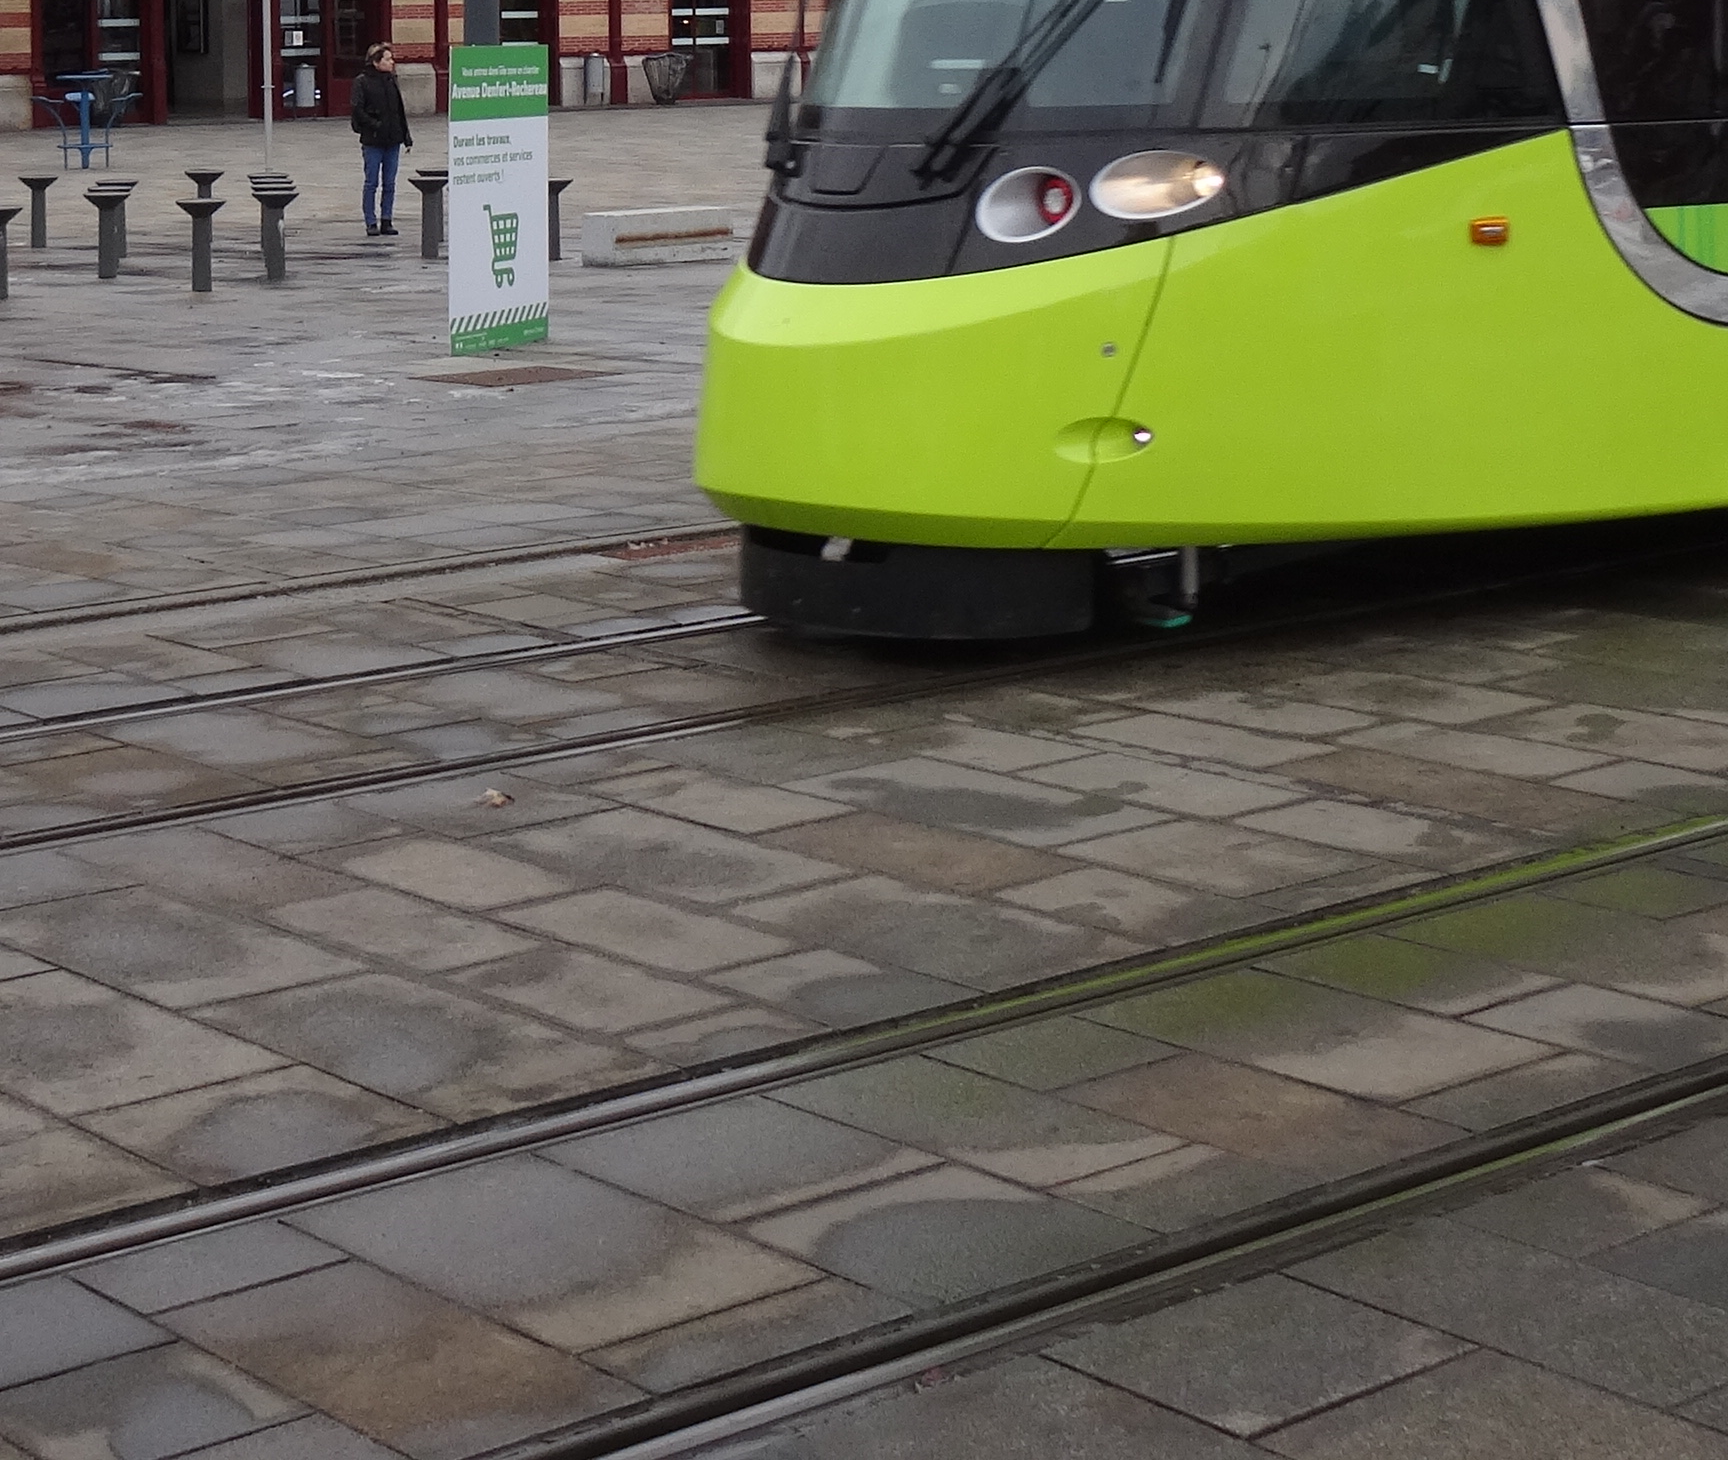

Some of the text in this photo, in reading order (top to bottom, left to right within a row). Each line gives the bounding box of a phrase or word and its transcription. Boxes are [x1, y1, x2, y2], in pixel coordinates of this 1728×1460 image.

[452, 83, 480, 99] Avenue
[453, 135, 475, 148] Durant
[475, 133, 486, 146] les
[453, 149, 533, 167] vos commerces et services
[453, 172, 476, 185] restent
[477, 171, 501, 184] ouverts
